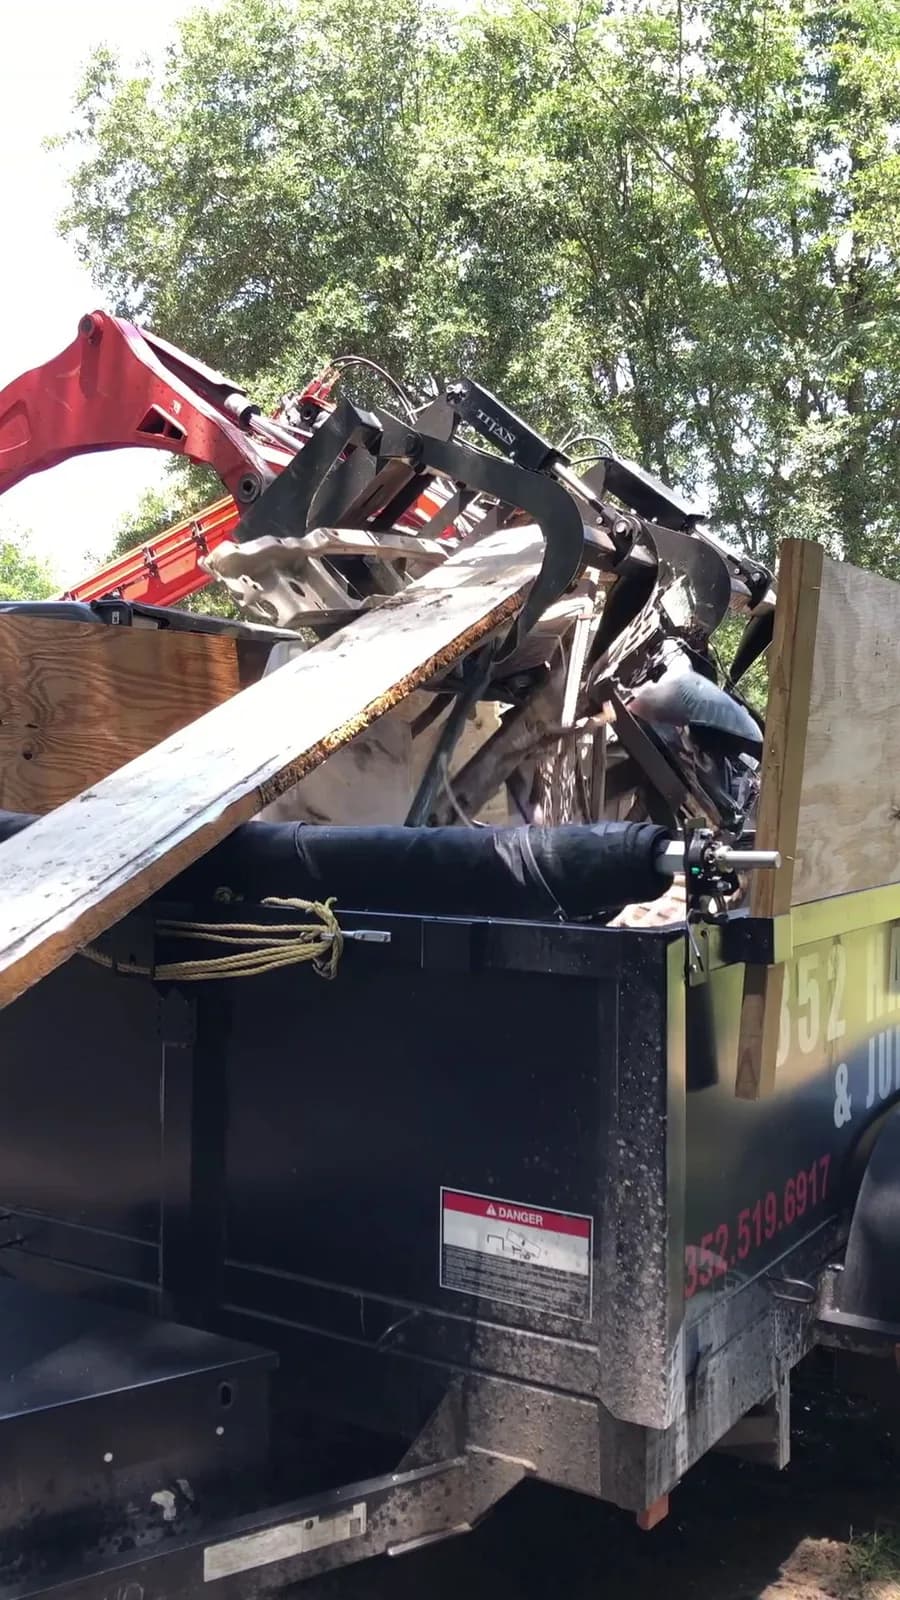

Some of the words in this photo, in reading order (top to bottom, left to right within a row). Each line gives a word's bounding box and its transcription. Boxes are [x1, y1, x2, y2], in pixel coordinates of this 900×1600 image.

[476, 408, 516, 446] TITAN
[833, 1062, 852, 1129] &
[498, 1206, 544, 1226] DANGER
[684, 1153, 831, 1298] 352.519.6917
